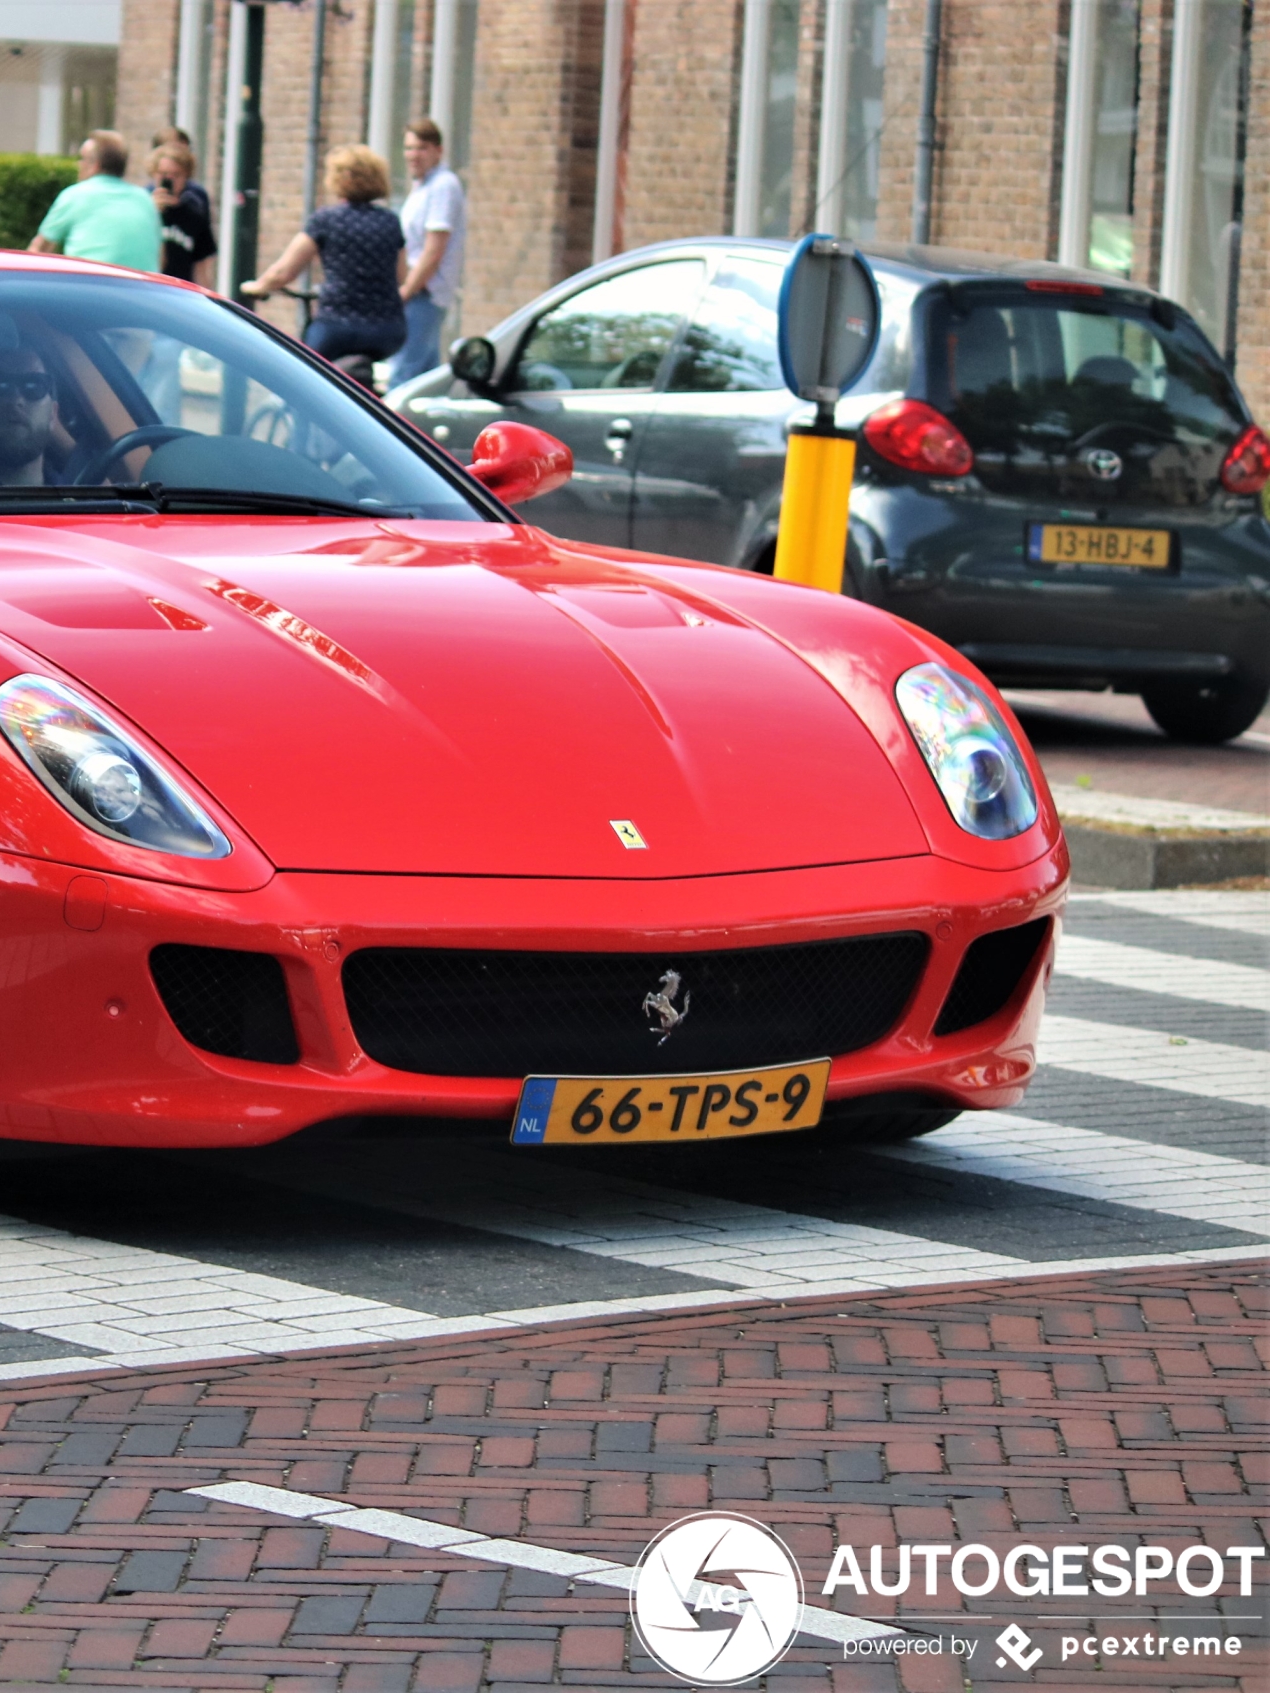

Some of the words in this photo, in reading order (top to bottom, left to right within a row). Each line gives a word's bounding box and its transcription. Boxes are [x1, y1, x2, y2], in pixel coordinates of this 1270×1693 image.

[1055, 530, 1155, 560] 13-HBJ-4
[571, 1074, 811, 1134] 66-TPS-9
[520, 1118, 541, 1132] NL
